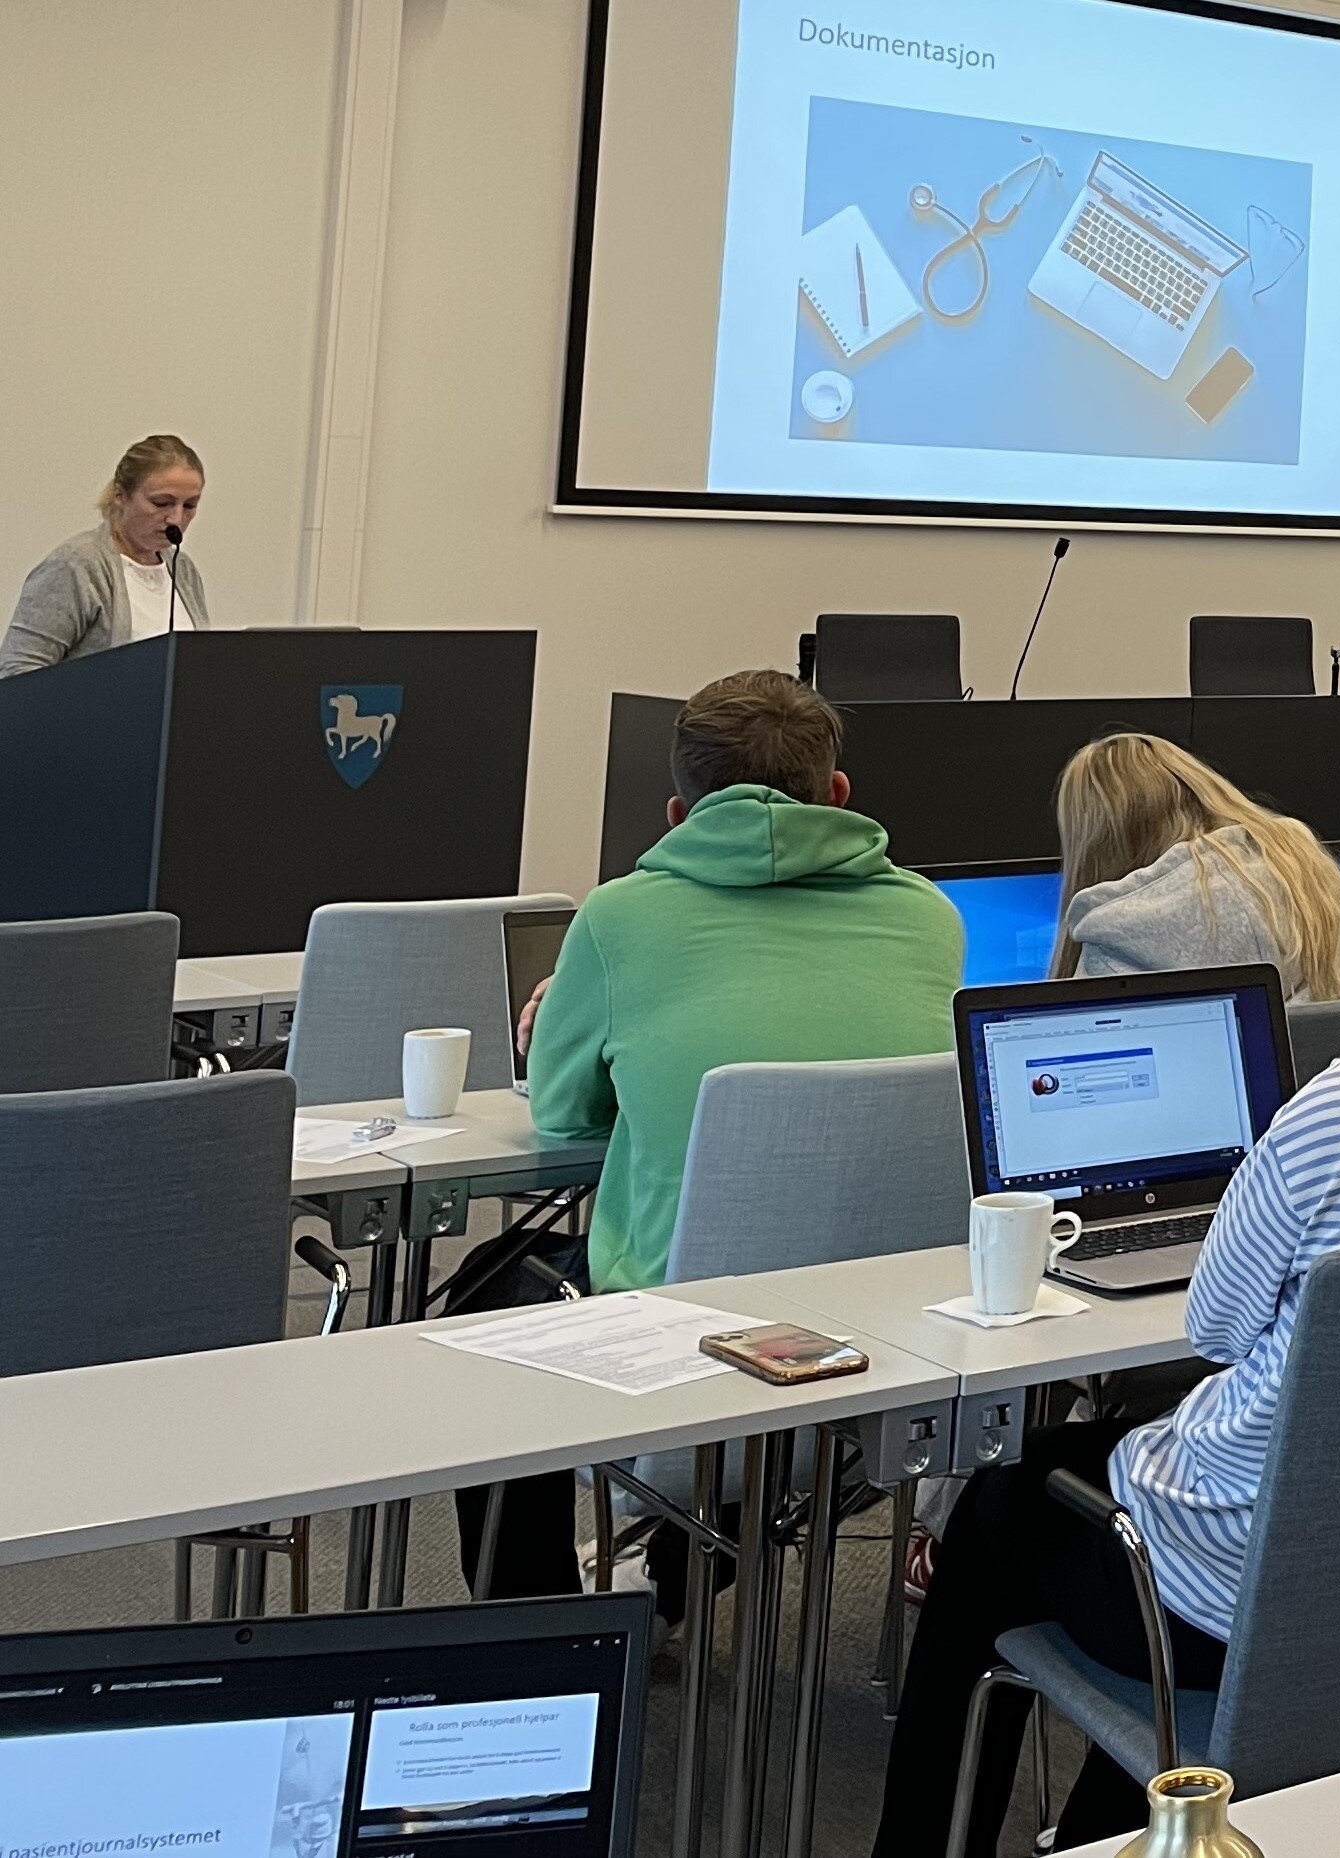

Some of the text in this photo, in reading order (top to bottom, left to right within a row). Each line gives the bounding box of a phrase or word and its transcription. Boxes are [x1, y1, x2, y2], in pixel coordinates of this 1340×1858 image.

[799, 18, 995, 70] Dokumentasjon
[437, 1721, 459, 1731] som
[461, 1714, 522, 1730] profesjonell
[9, 1828, 221, 1858] pasientjournalsystemet
